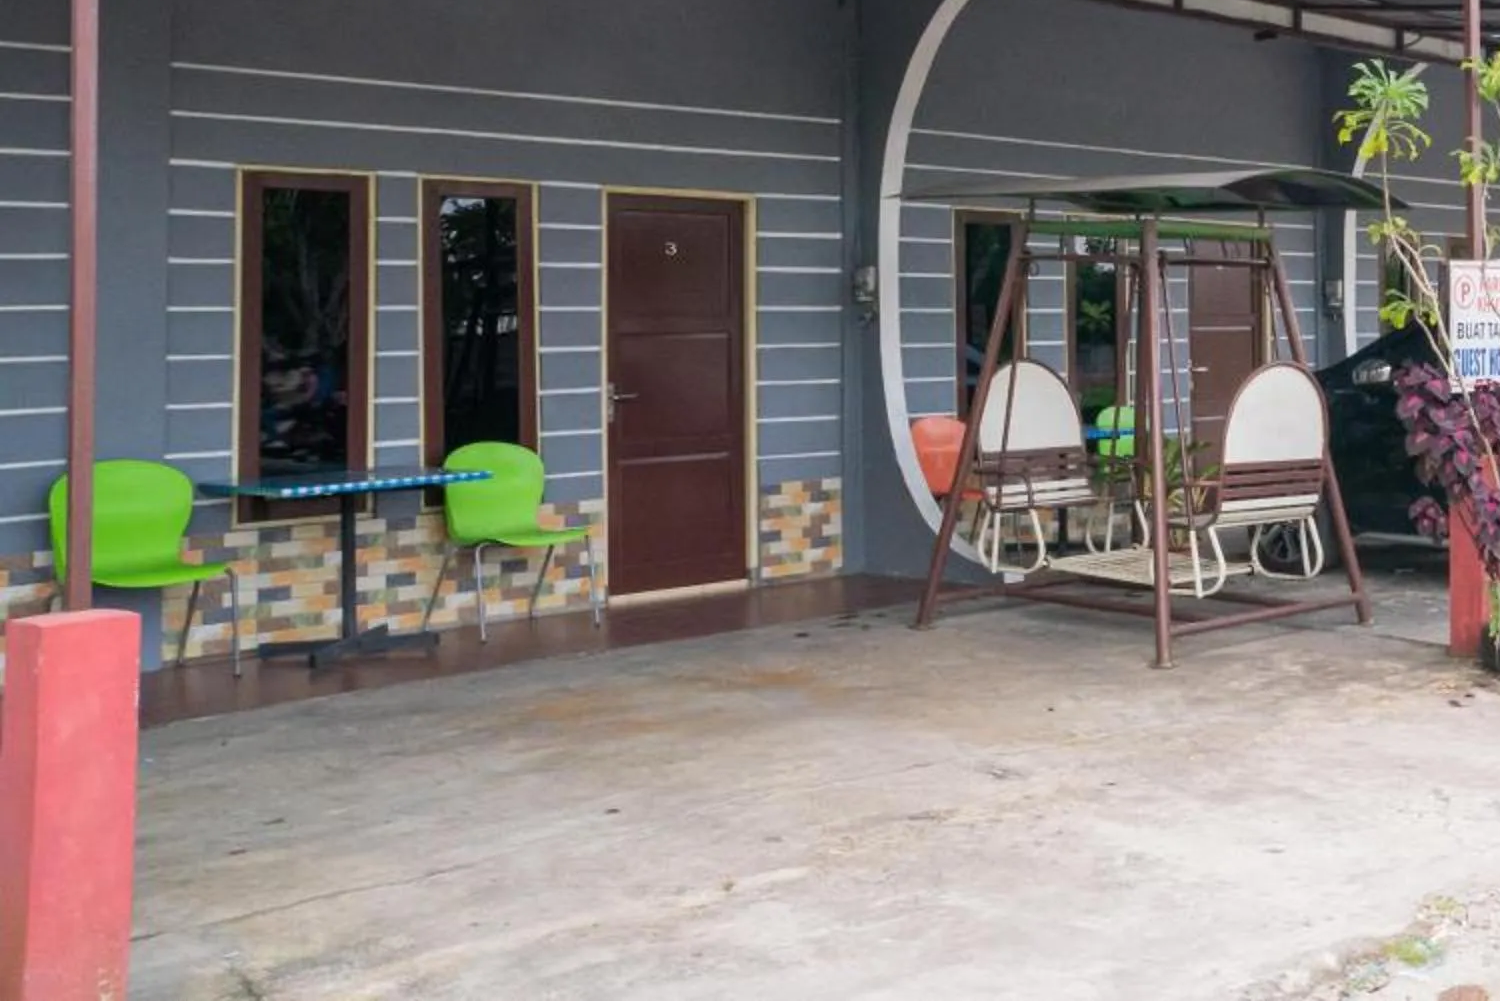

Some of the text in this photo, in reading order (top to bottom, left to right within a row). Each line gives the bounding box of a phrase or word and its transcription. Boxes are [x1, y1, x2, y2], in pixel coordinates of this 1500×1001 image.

[664, 241, 677, 256] 3
[1461, 281, 1471, 301] P
[1457, 322, 1485, 340] BUAT
